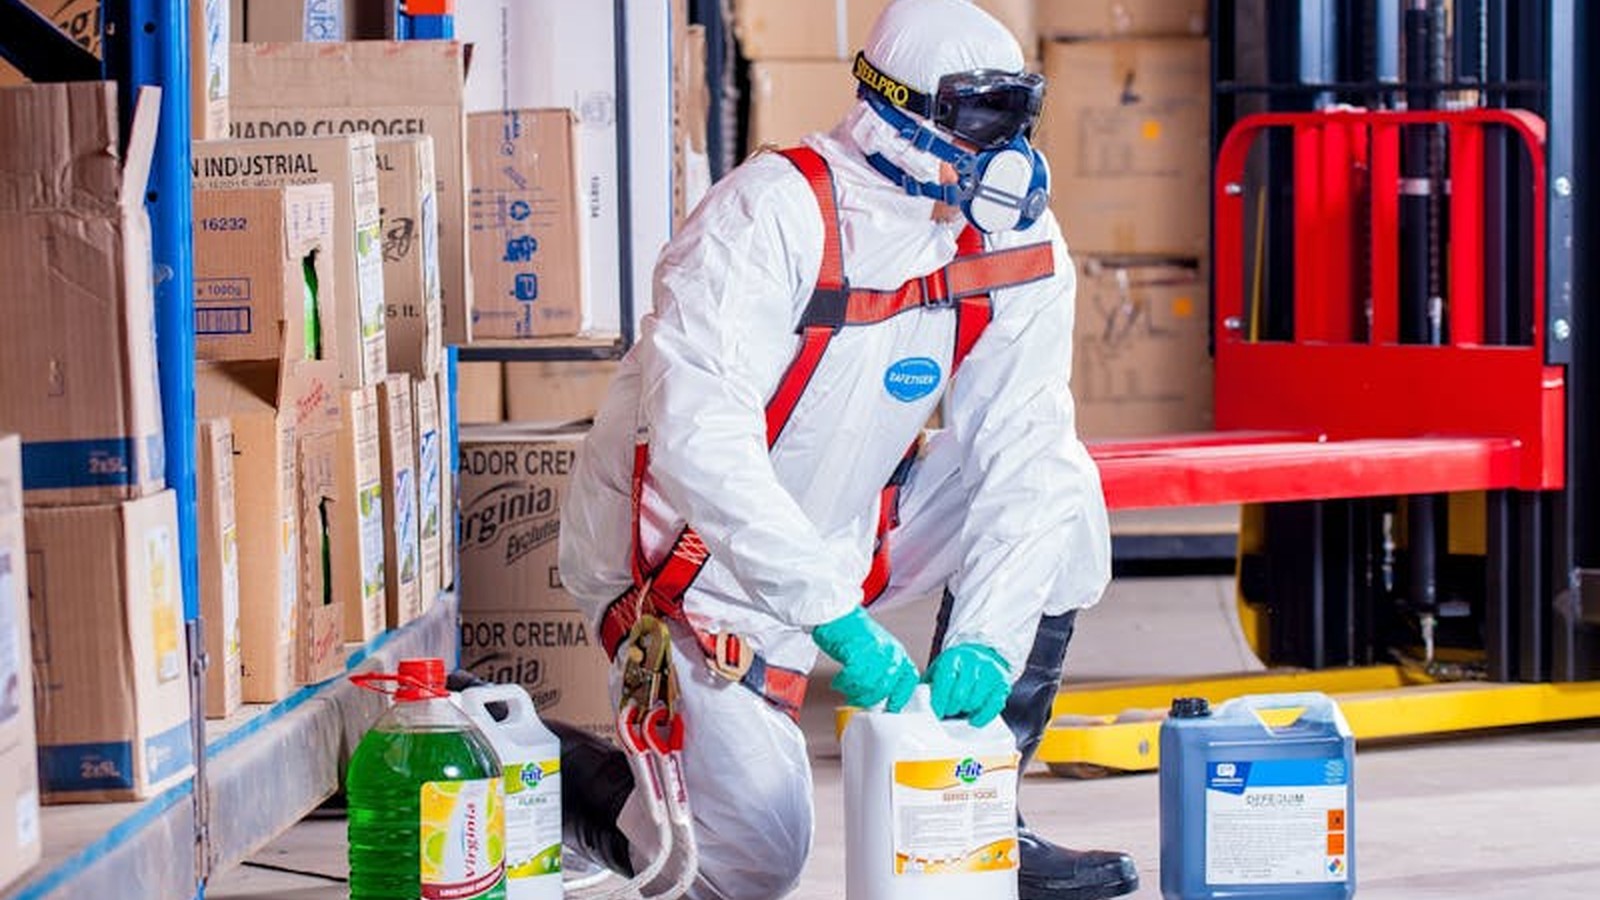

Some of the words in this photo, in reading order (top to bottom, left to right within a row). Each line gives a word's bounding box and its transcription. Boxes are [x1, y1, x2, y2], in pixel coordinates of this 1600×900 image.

[854, 57, 909, 105] STEELPRO
[204, 153, 318, 177] INDUSTRIAL
[201, 217, 247, 231] 16232
[513, 621, 589, 647] CREMA
